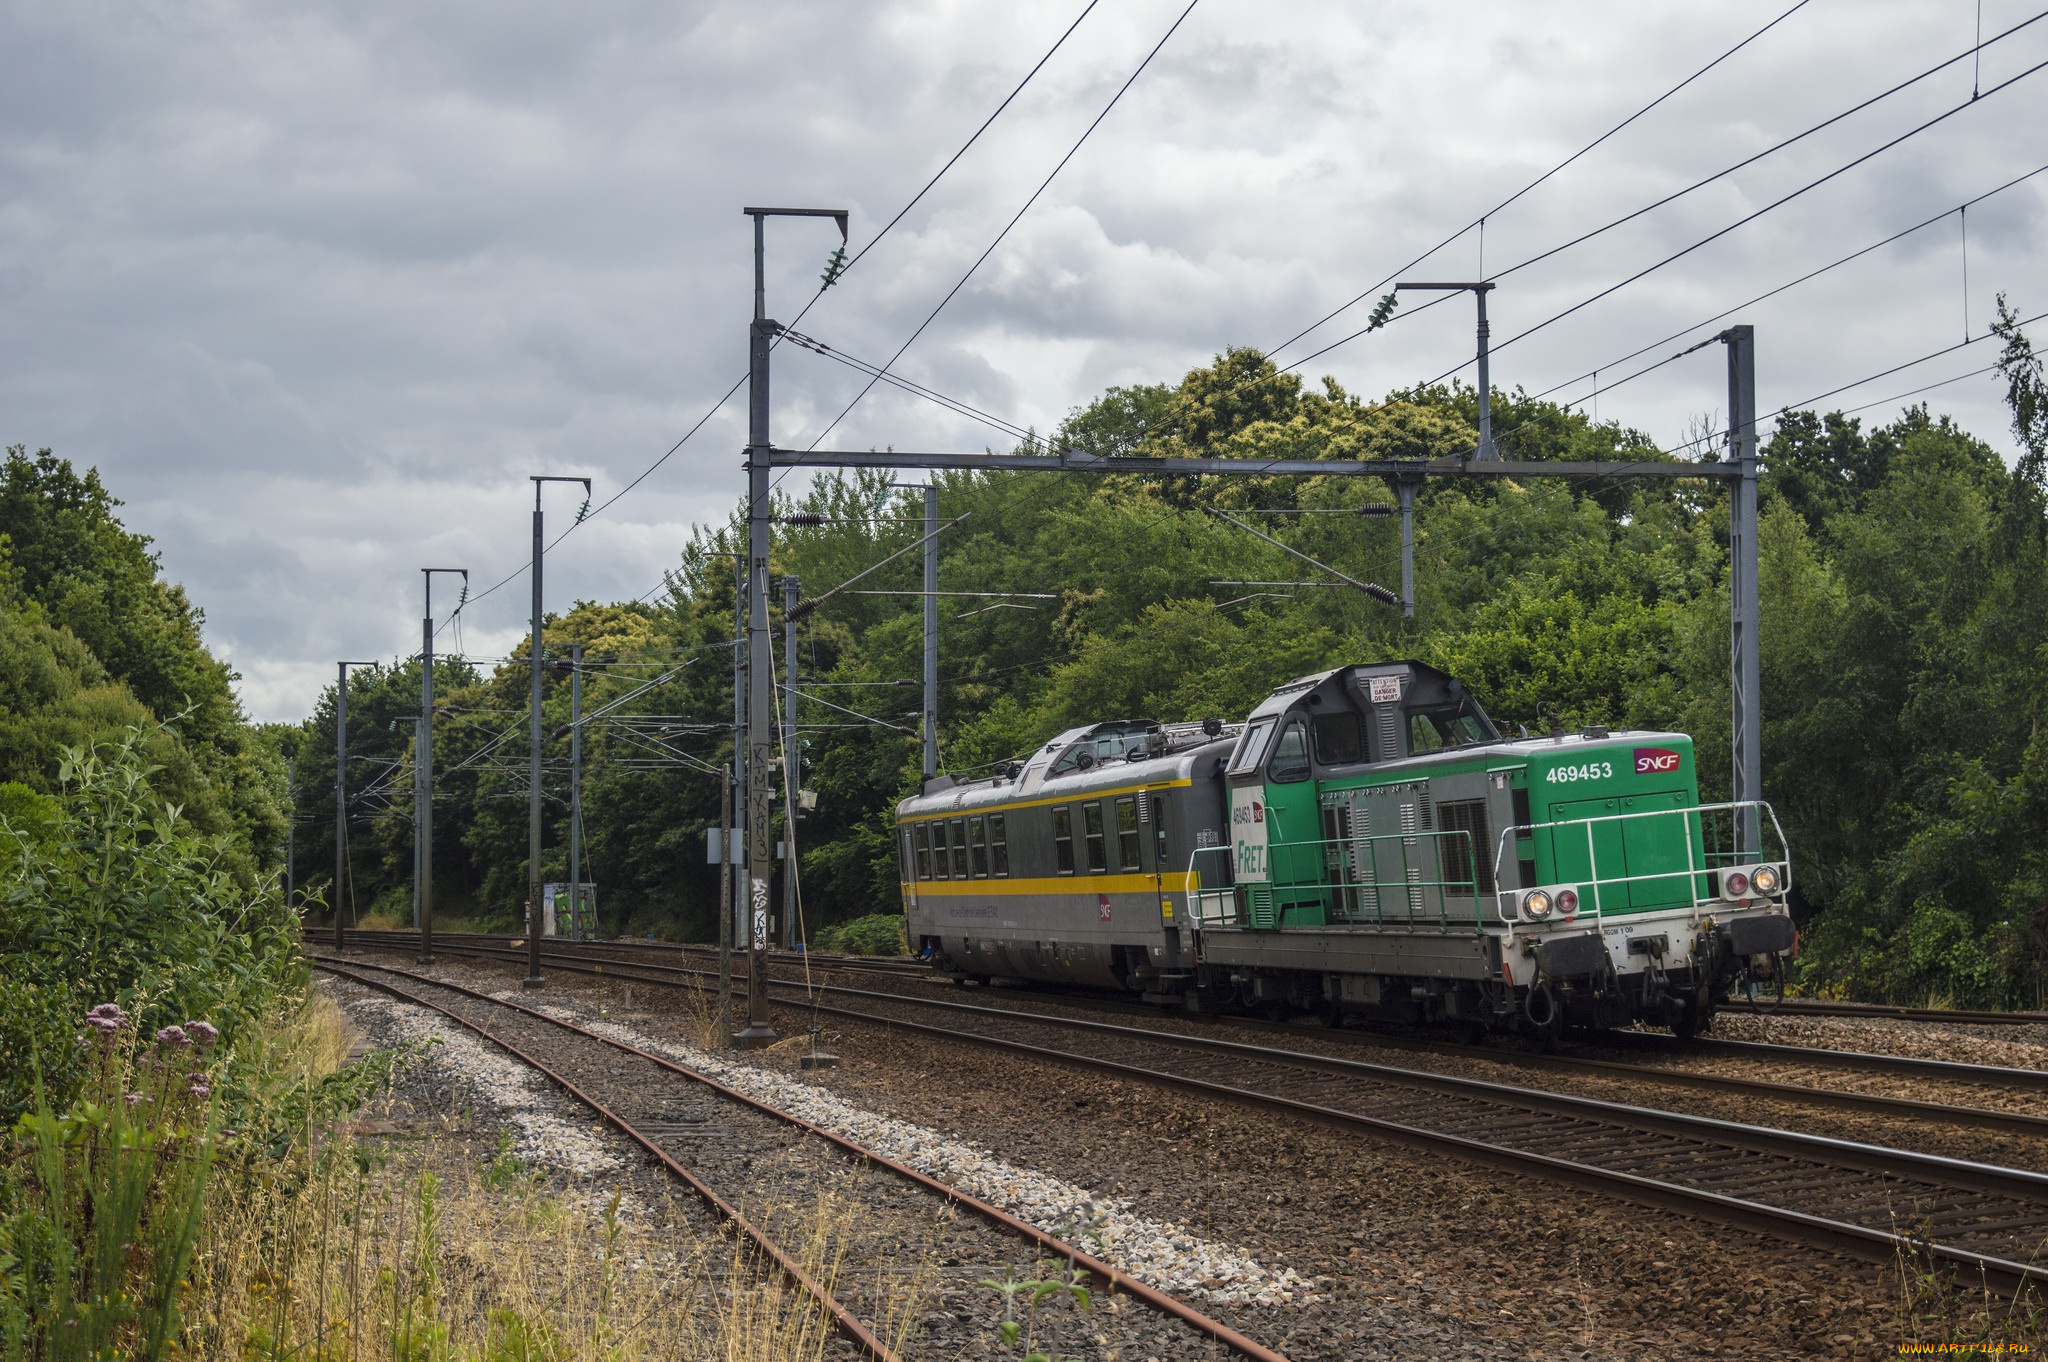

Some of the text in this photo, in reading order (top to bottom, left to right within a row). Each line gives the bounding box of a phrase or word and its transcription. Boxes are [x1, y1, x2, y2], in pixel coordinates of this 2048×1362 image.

[1637, 755, 1679, 771] SNCF
[1546, 762, 1613, 783] 469453
[1234, 806, 1263, 824] 469453 SNCF
[1238, 840, 1263, 873] FRET
[1100, 904, 1110, 917] SNCF
